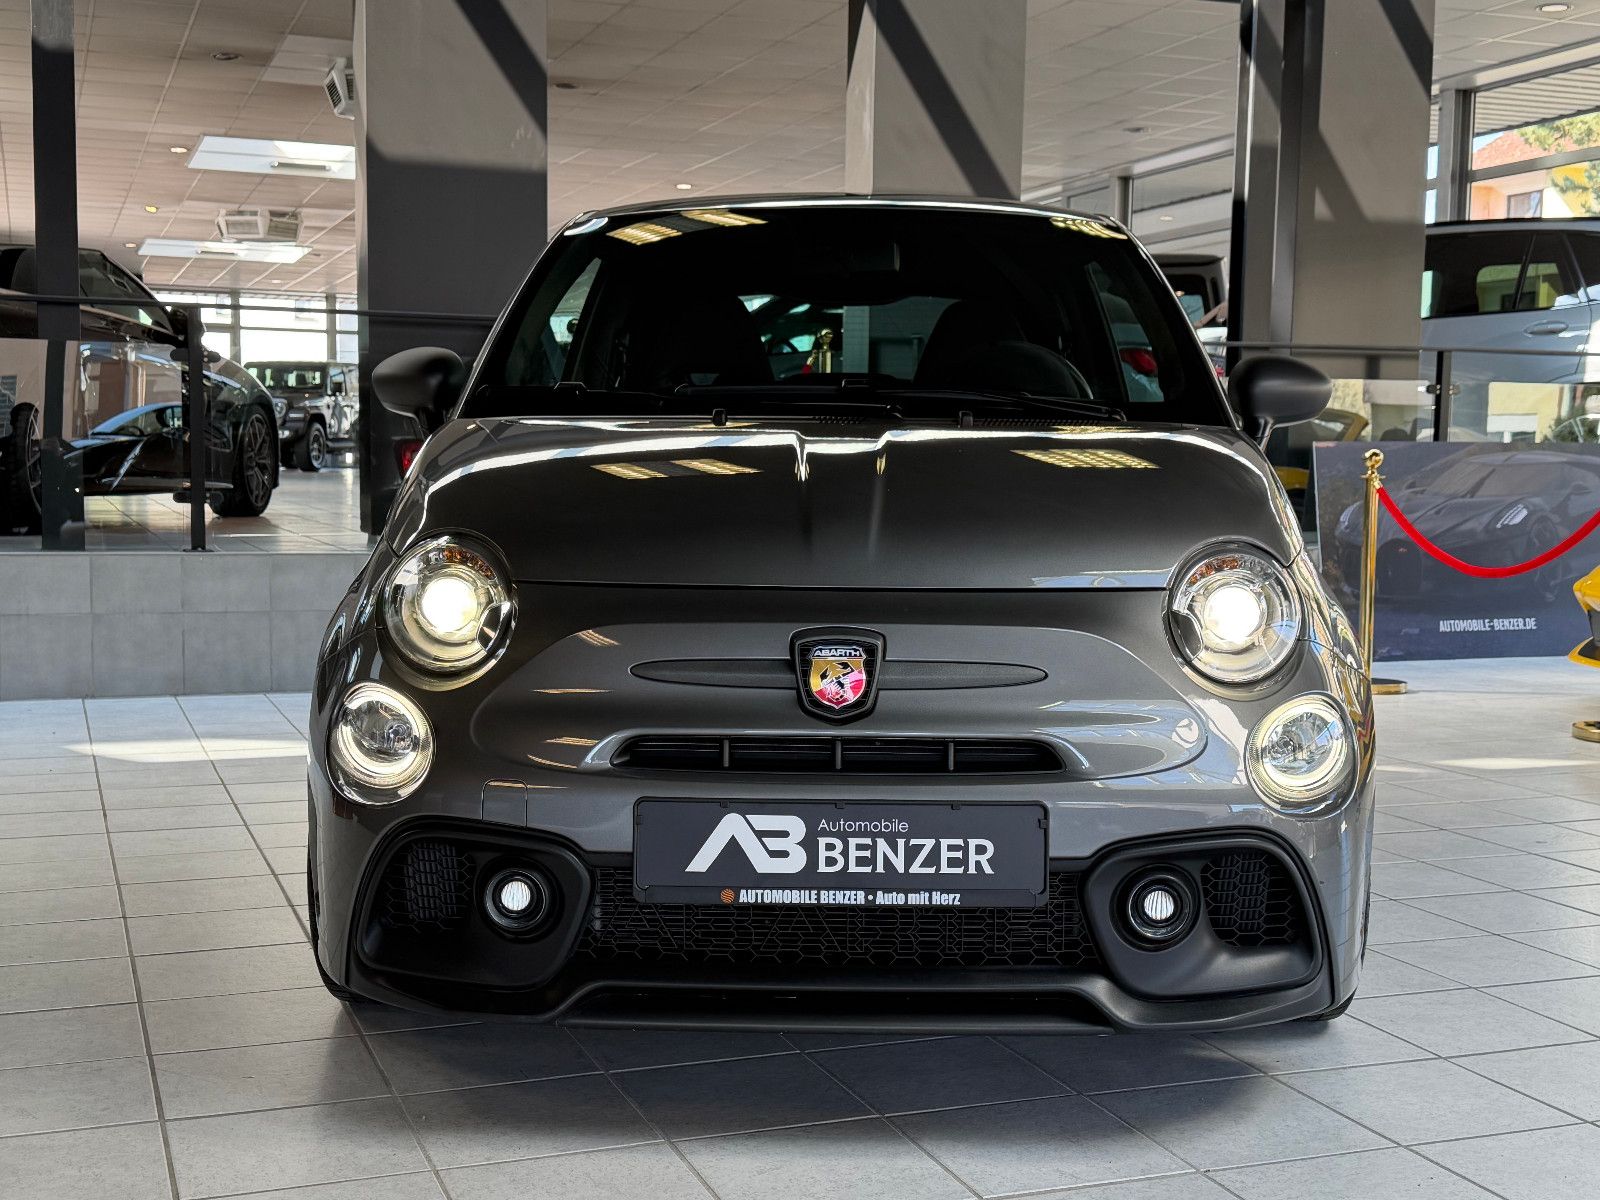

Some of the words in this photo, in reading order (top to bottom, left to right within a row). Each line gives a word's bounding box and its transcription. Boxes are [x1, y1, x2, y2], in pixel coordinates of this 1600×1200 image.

[1439, 617, 1537, 633] AUTOMOBILE-BENZER.DE
[813, 648, 860, 657] ABARTH
[817, 817, 909, 833] Automobile
[816, 837, 995, 875] BENZER
[738, 889, 818, 905] AUTOMOBILE
[819, 889, 866, 905] BENZER
[875, 890, 906, 906] Auto
[907, 890, 930, 906] mit
[931, 891, 961, 906] Herz
